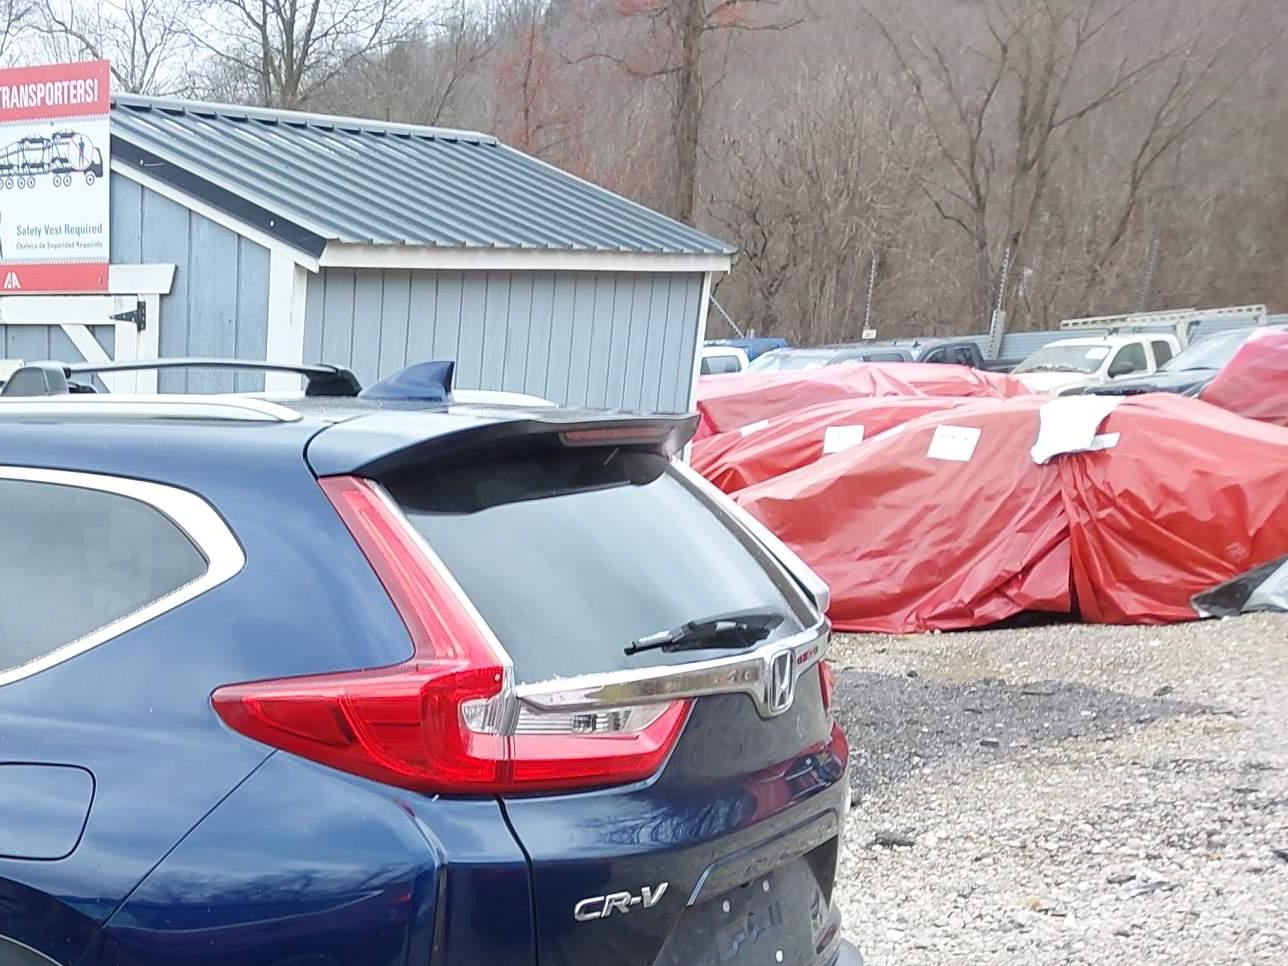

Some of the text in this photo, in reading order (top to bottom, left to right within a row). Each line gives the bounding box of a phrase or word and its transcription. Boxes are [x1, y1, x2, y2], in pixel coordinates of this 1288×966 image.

[16, 223, 103, 238] Safety Vest Required
[574, 882, 670, 921] CR-V
